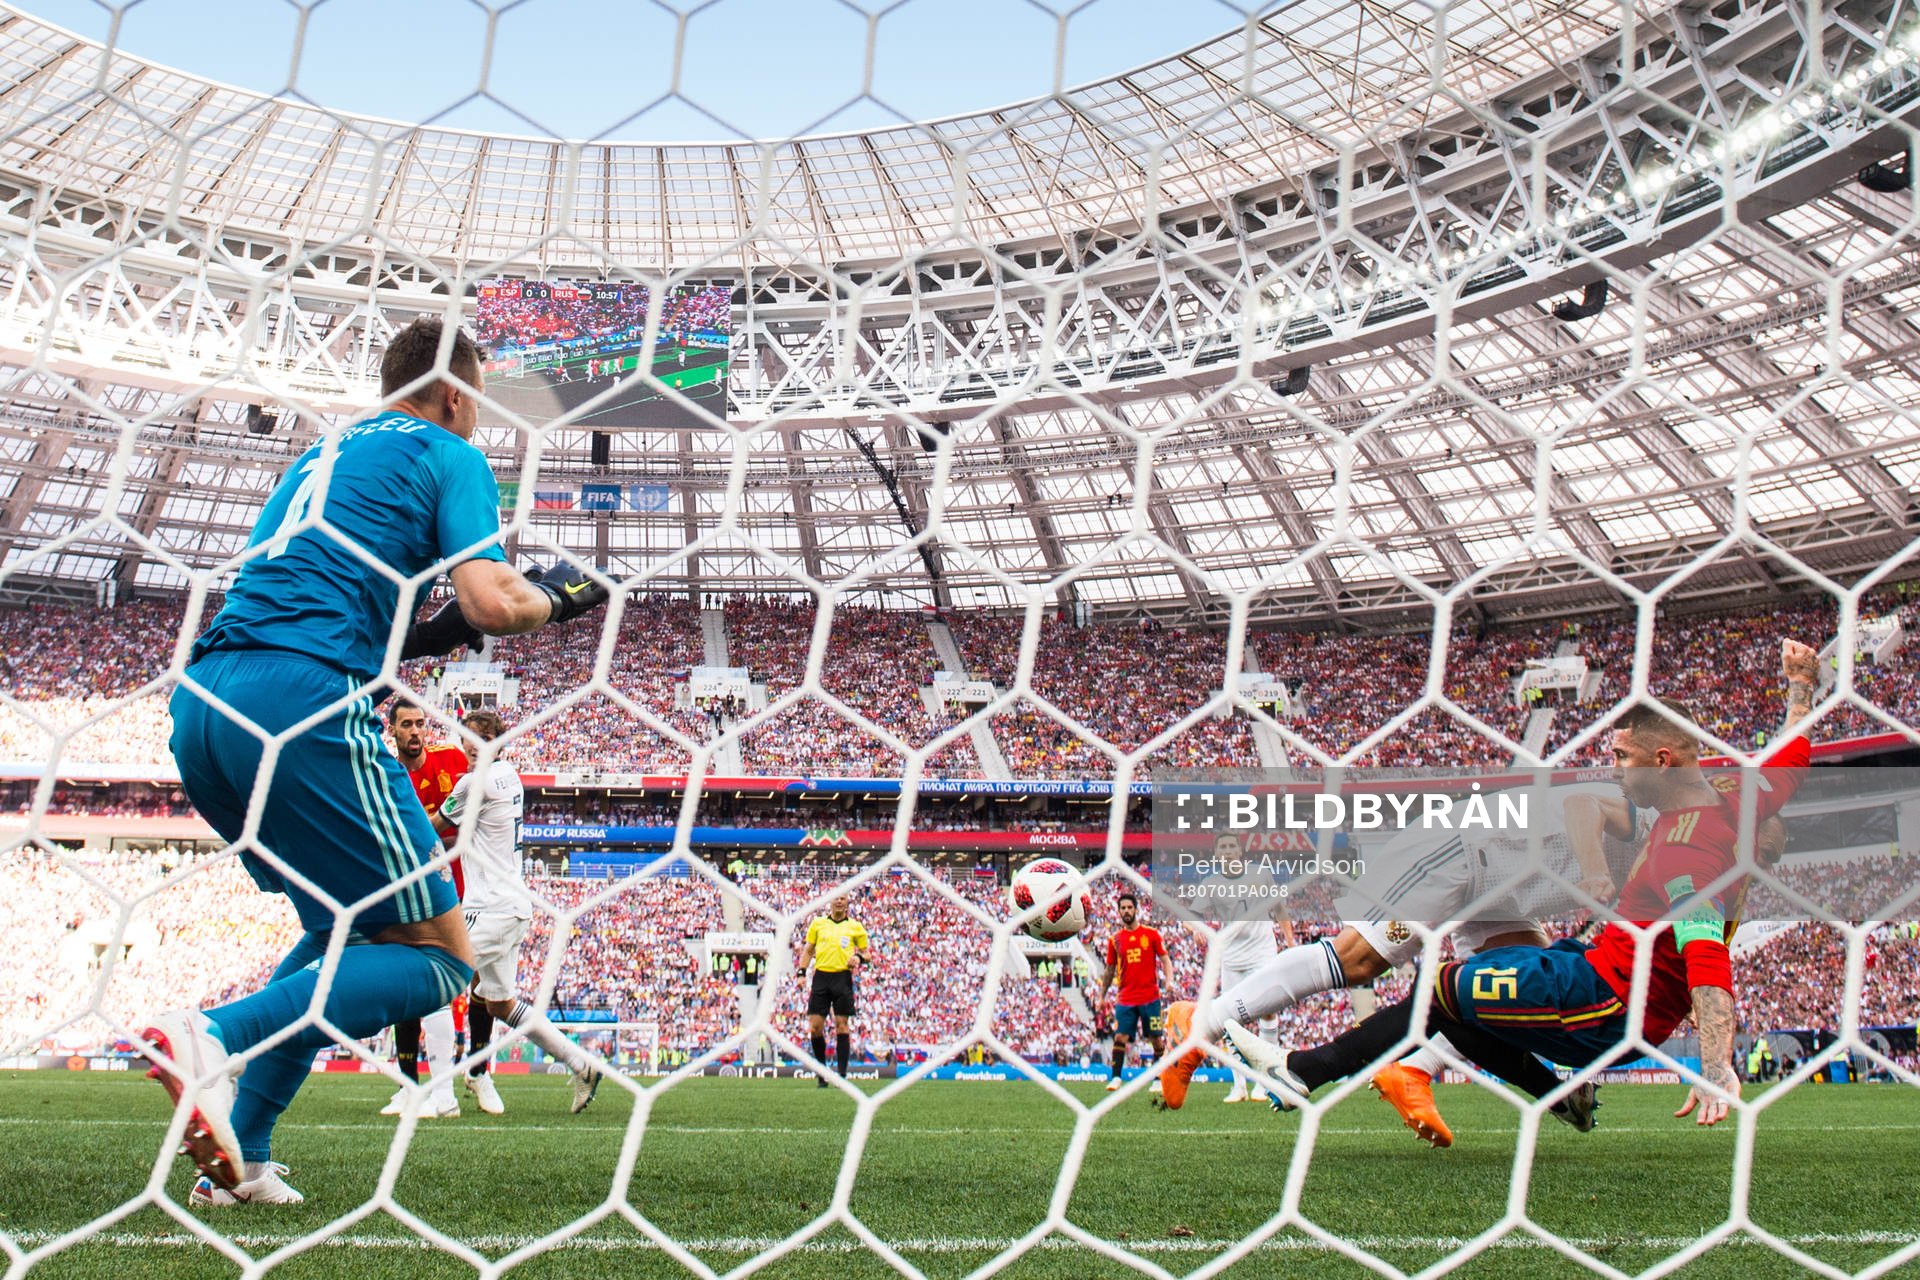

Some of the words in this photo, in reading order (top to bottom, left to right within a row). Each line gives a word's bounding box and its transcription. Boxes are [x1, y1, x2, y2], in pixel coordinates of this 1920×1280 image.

[500, 288, 517, 297] ESP
[526, 289, 533, 298] 0
[540, 289, 547, 298] 0
[555, 290, 574, 298] RUS
[596, 291, 618, 300] 10:57
[587, 491, 615, 503] FIFA
[963, 782, 994, 793] МИРА
[996, 783, 1011, 793] ПО
[1013, 783, 1061, 794] ФУТБОЛУ
[1063, 784, 1085, 794] FIFA
[1086, 784, 1110, 794] 2018
[1127, 785, 1162, 794] ОССИИ
[521, 827, 543, 838] RLD
[543, 828, 566, 838] CUP
[567, 829, 607, 839] RUSSIA
[1029, 834, 1077, 846] МОСКВА
[1126, 947, 1141, 963] 22
[1472, 966, 1518, 1000] 15
[1150, 1015, 1163, 1031] 22
